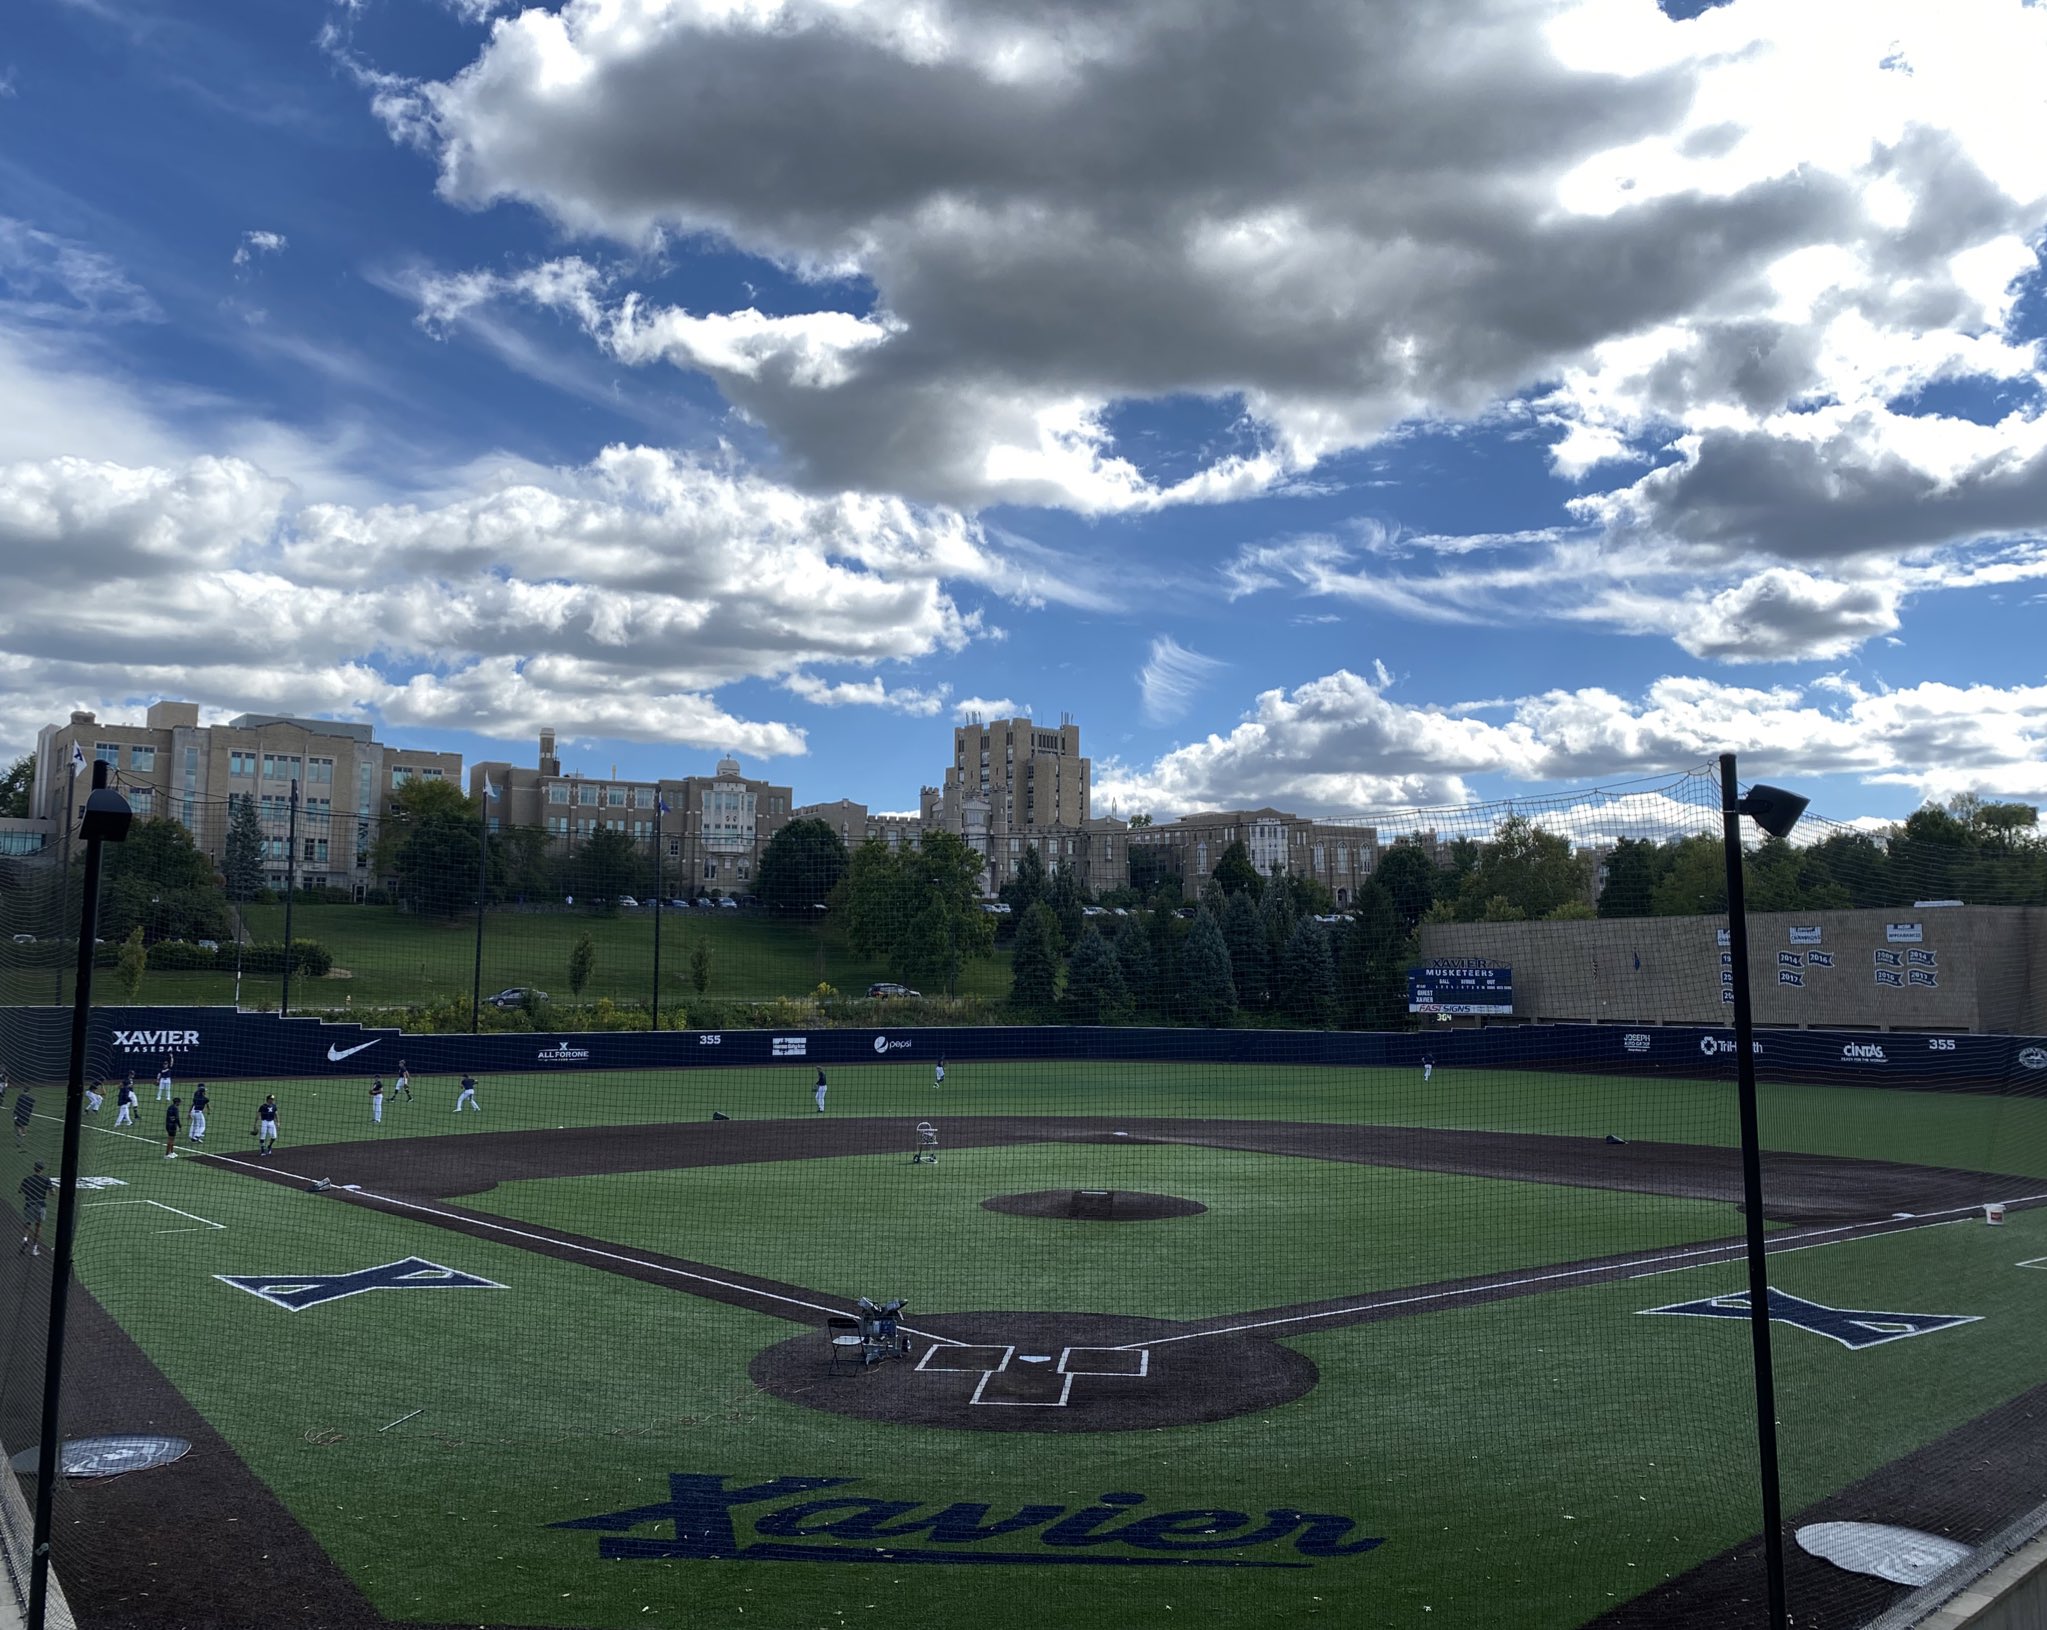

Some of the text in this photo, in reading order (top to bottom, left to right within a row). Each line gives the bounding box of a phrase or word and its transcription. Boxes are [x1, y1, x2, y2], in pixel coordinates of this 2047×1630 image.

[1433, 959, 1487, 968] XAVIER
[1780, 954, 1798, 964] 2014
[1810, 953, 1828, 964] 2016
[1426, 969, 1494, 977] MUSKETEERS
[1780, 973, 1798, 983] 2017
[112, 1030, 200, 1046] XAVIER
[699, 1035, 721, 1045] 355
[889, 1039, 912, 1050] pepsi
[1929, 1039, 1956, 1050] 355
[546, 1473, 1387, 1562] Xavier
